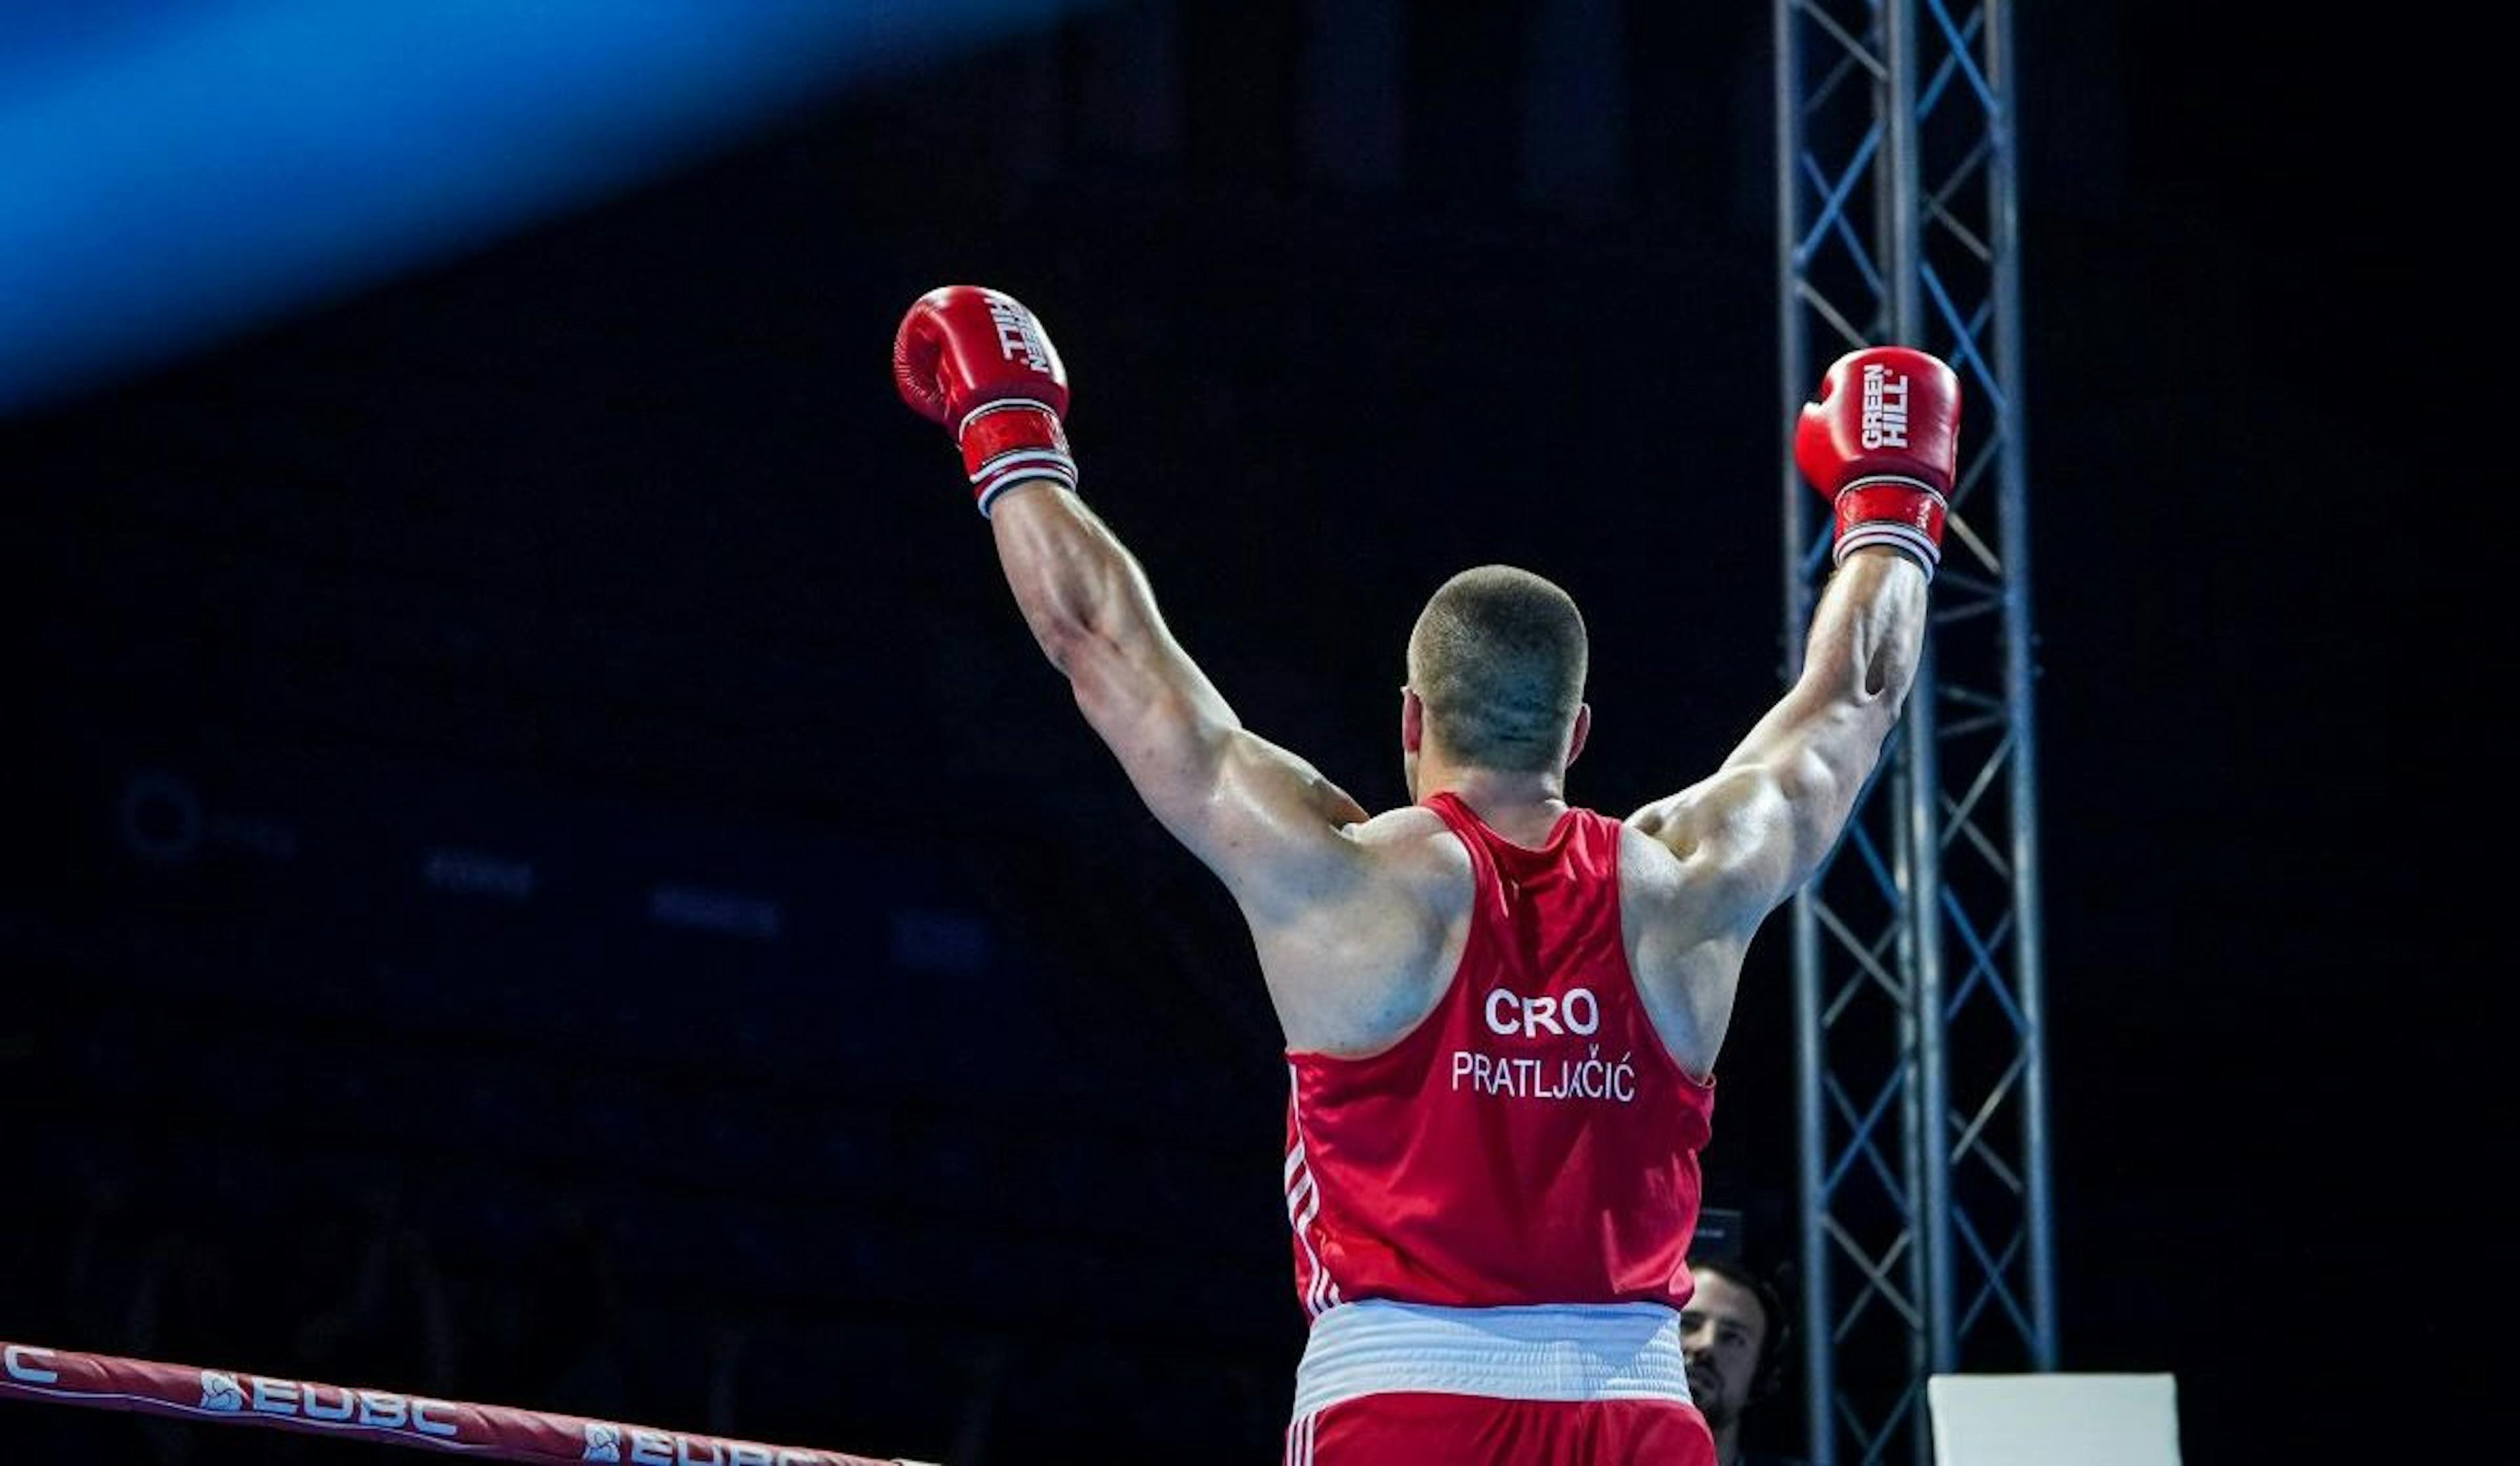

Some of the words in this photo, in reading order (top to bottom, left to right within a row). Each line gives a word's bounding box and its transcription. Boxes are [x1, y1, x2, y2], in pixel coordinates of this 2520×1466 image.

[984, 297, 1026, 360] HILL
[1862, 364, 1883, 450] GREEN
[1882, 375, 1908, 448] HILL
[1485, 988, 1599, 1038] CRO
[1452, 1043, 1635, 1102] PRATLJAČIĆ
[252, 1377, 457, 1435] EUBC
